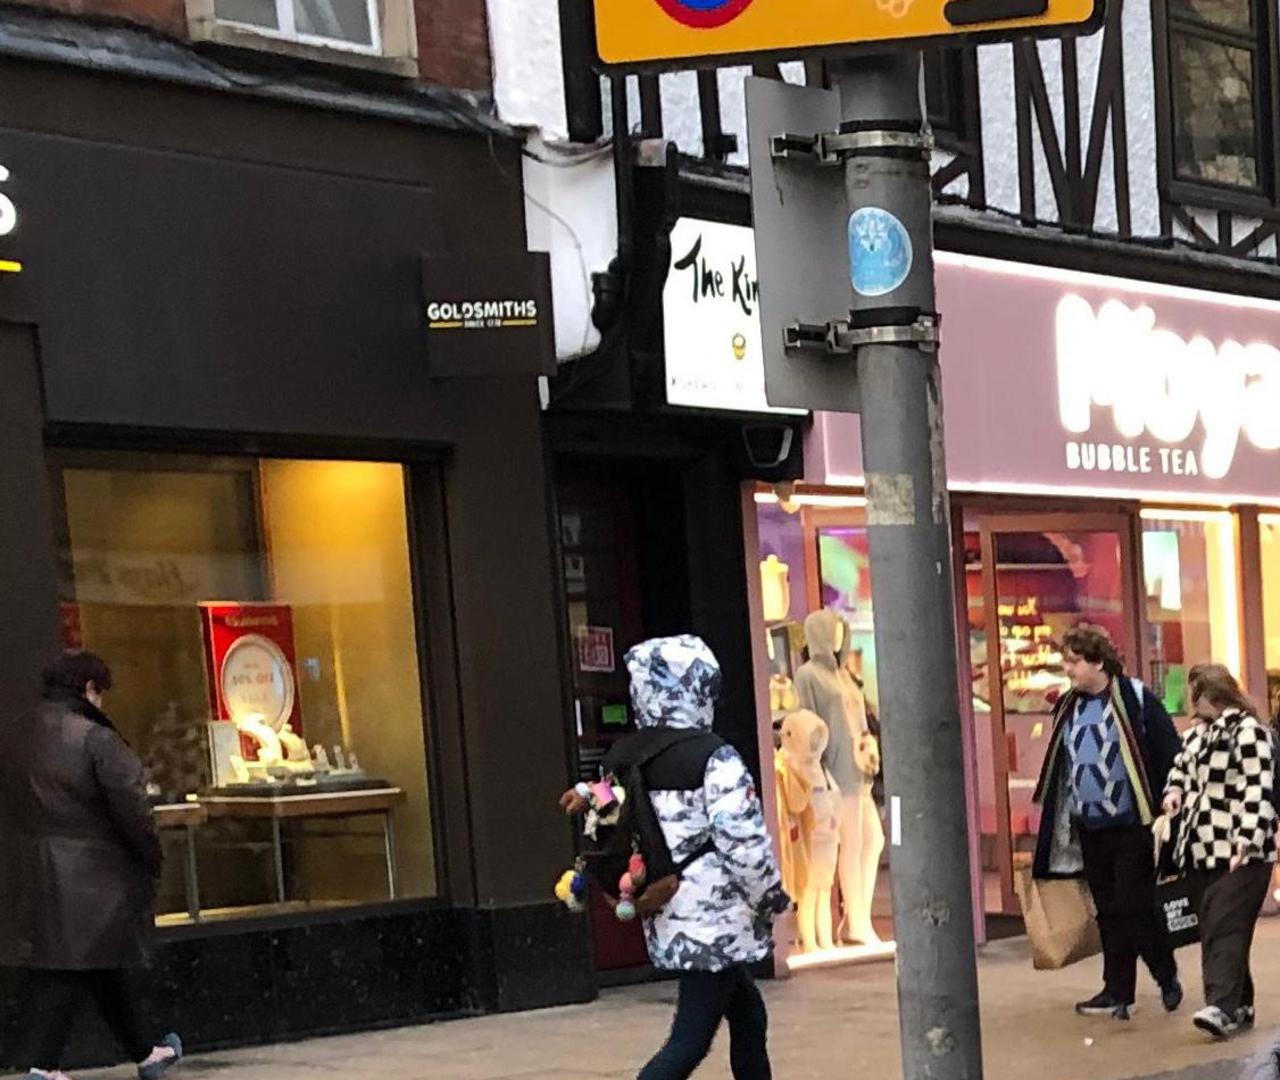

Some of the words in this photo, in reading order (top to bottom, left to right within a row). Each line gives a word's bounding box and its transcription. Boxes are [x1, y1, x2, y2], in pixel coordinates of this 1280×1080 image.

[674, 232, 724, 303] The
[427, 300, 537, 320] GOLDSMITHS
[1066, 442, 1152, 473] BUBBLE
[1159, 448, 1199, 475] TEA
